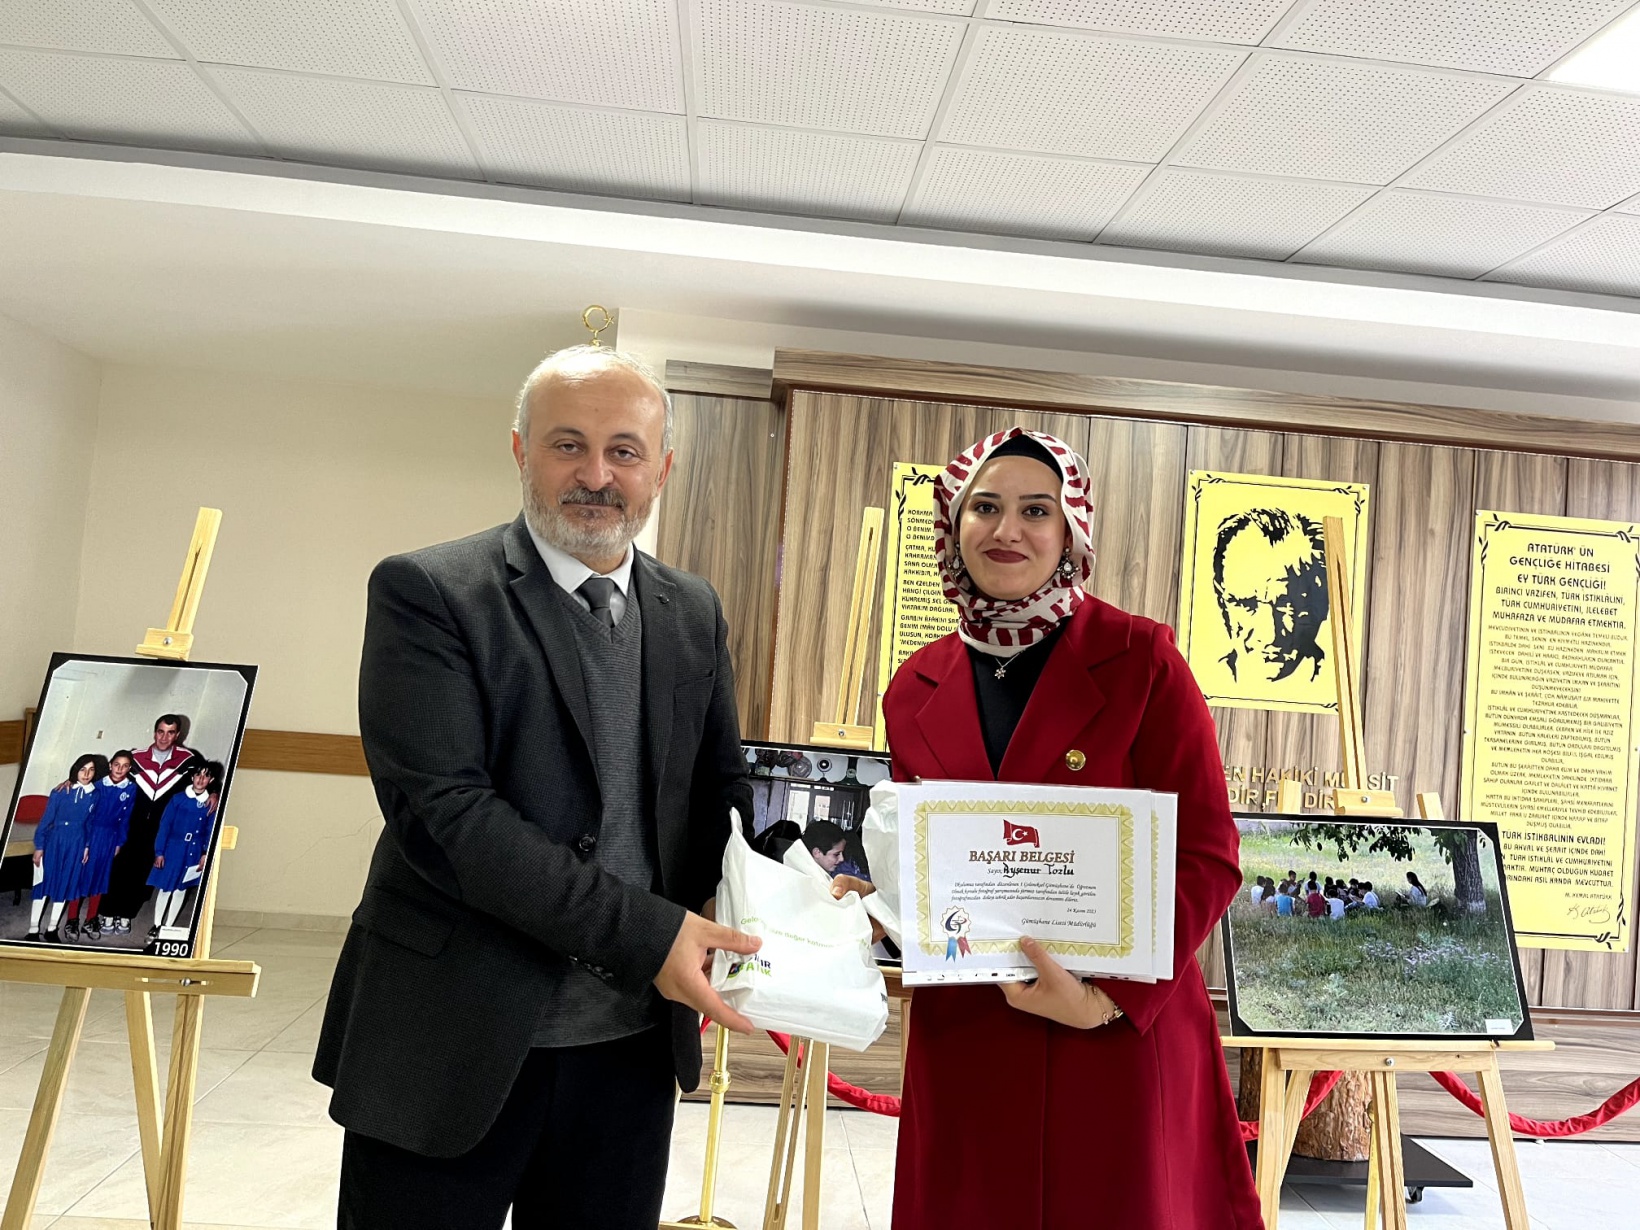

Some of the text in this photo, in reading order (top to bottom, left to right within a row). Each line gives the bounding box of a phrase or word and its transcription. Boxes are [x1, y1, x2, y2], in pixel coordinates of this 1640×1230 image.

[1579, 544, 1593, 557] ÜN
[1565, 557, 1610, 573] HİTABESİ
[1517, 573, 1528, 582] EY
[1532, 571, 1555, 585] TÜRK
[1492, 610, 1534, 621] MUHAFAZA
[1536, 614, 1545, 622] VE
[969, 848, 1074, 865] BAŞARI BELGESİ
[1043, 863, 1074, 875] Tozlu
[154, 942, 188, 957] 1990
